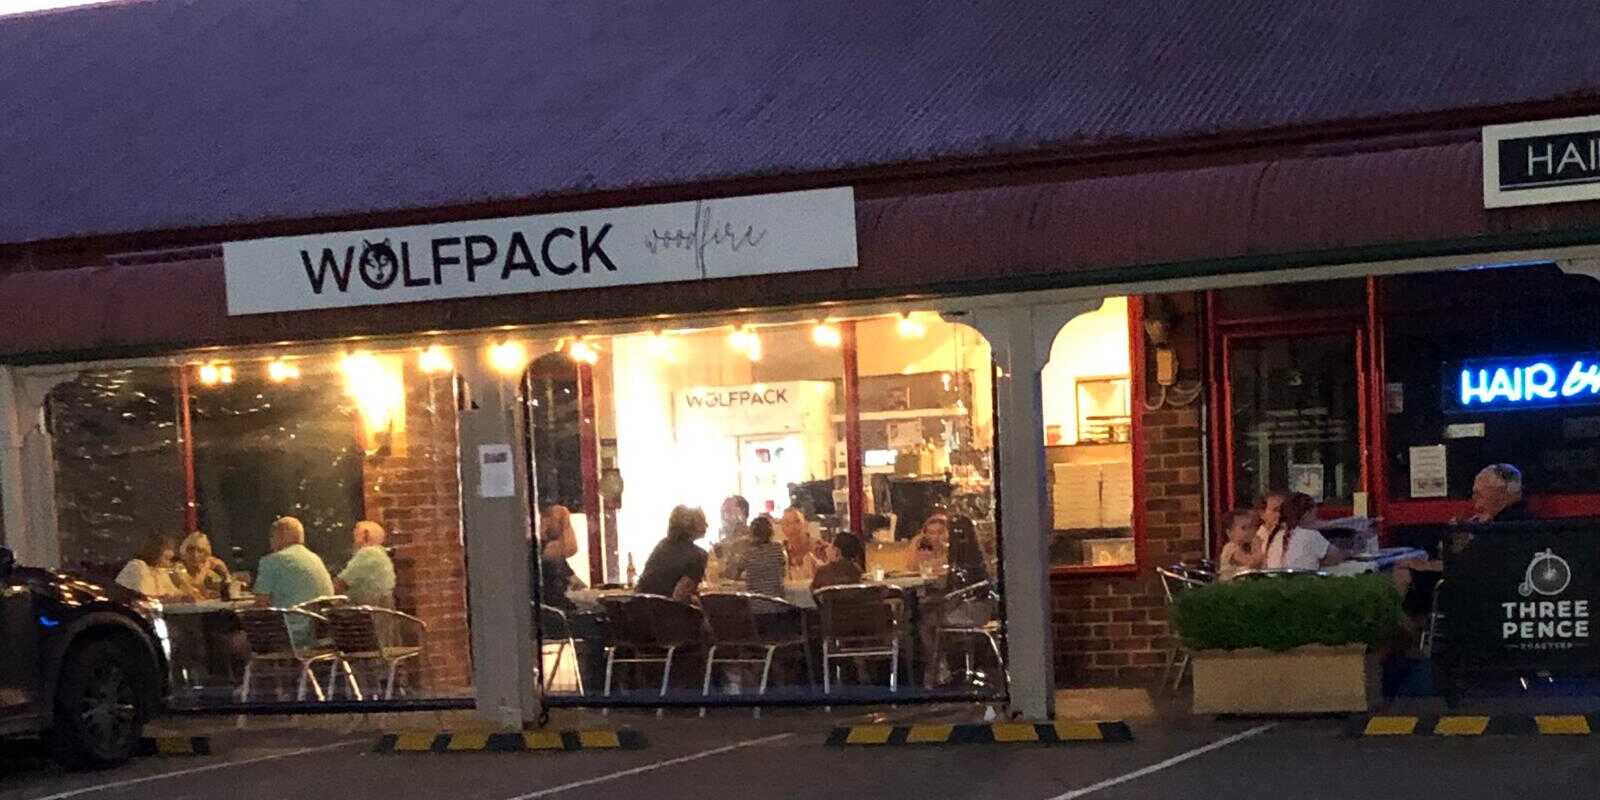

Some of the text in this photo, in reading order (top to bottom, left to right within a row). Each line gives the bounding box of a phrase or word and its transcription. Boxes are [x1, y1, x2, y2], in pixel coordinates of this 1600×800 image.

[1528, 138, 1600, 177] HAI
[301, 199, 767, 294] WOLFPACK woodfire
[686, 388, 788, 407] WOLFPACK
[1461, 363, 1557, 405] HAIR
[1502, 600, 1589, 619] THREE
[1503, 620, 1589, 638] PENCE
